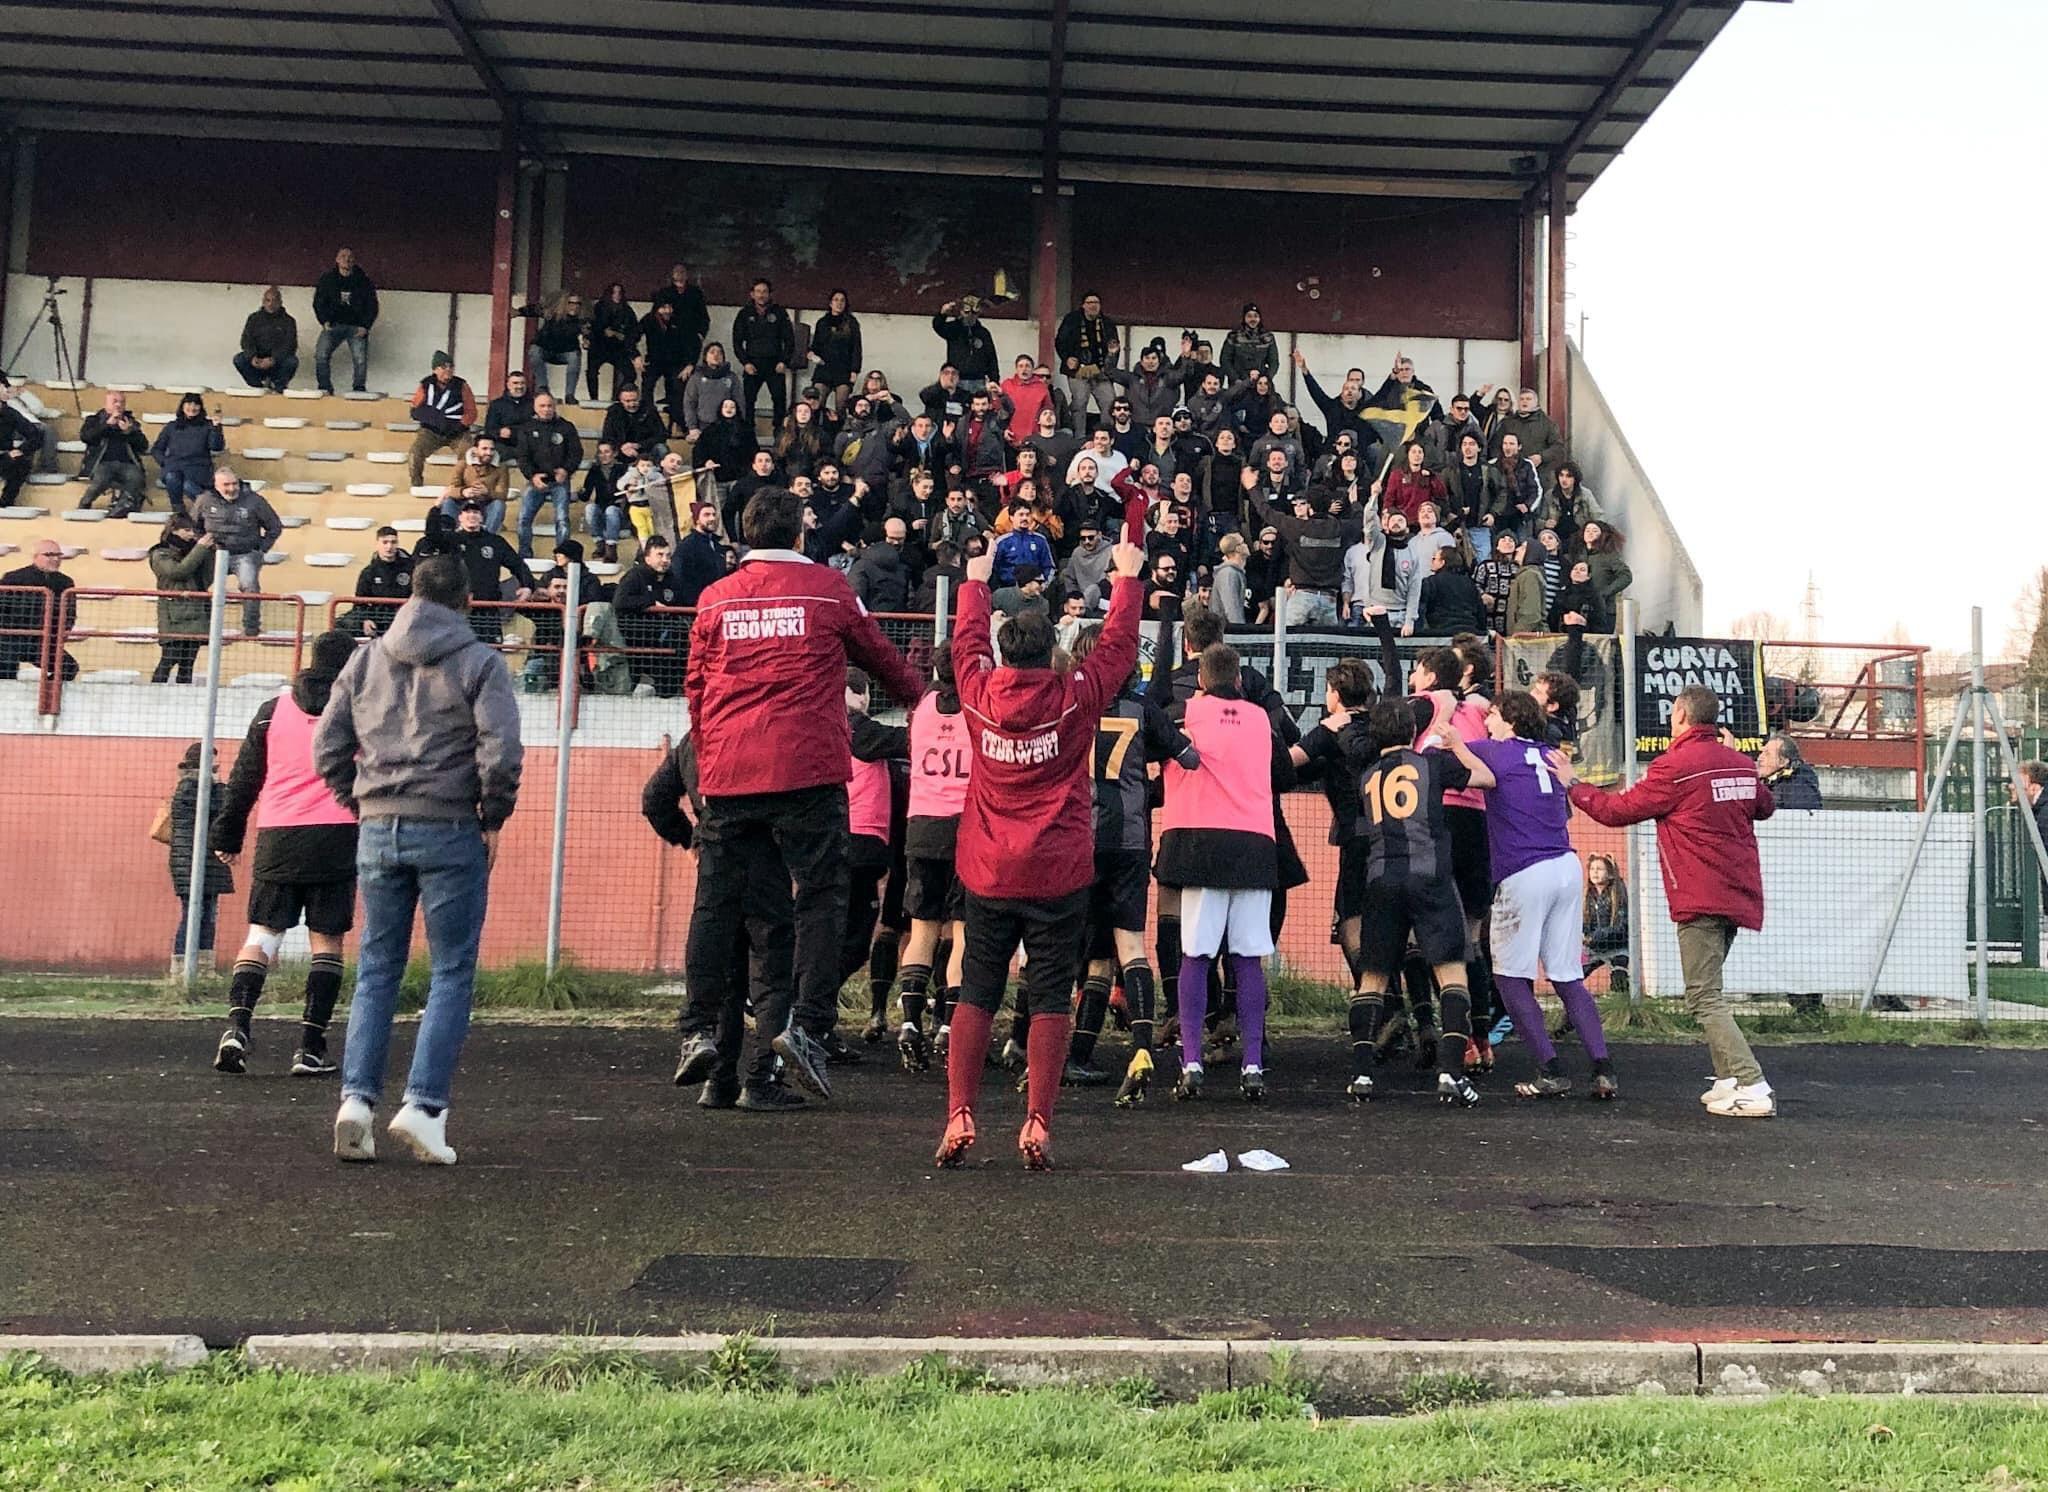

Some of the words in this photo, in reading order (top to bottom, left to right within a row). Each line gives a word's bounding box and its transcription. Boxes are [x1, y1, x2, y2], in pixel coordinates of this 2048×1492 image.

[762, 606, 805, 620] STORICO
[723, 618, 805, 640] LEBOWSKI
[1647, 645, 1738, 671] CURVA
[922, 748, 970, 778] CSL
[982, 737, 1059, 765] LEBOWSKI
[1524, 747, 1553, 793] 1
[1365, 764, 1419, 825] 16
